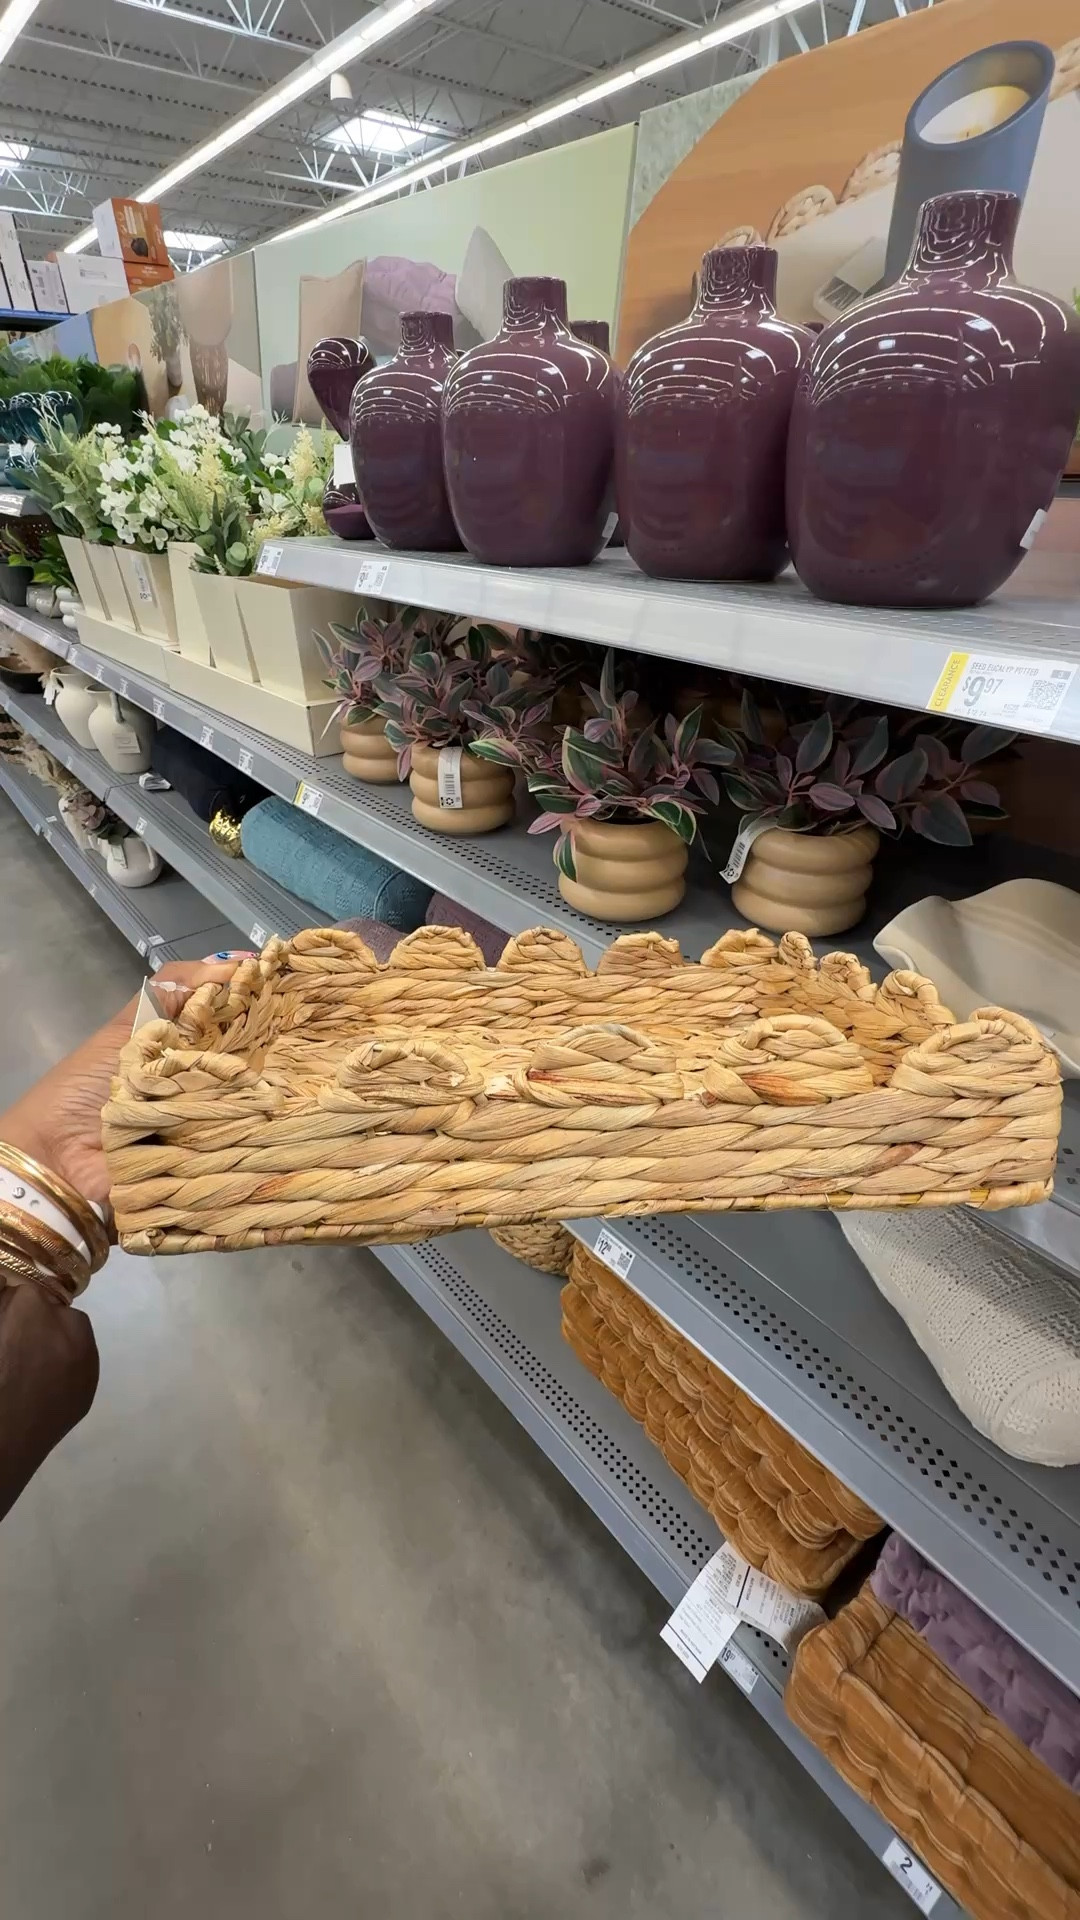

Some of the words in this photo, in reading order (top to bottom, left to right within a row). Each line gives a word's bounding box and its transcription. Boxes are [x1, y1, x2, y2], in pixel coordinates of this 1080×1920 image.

[971, 662, 986, 671] SEED
[987, 663, 1014, 673] EUCALYP
[934, 659, 960, 706] CLEARANCE
[899, 1857, 912, 1874] 2
